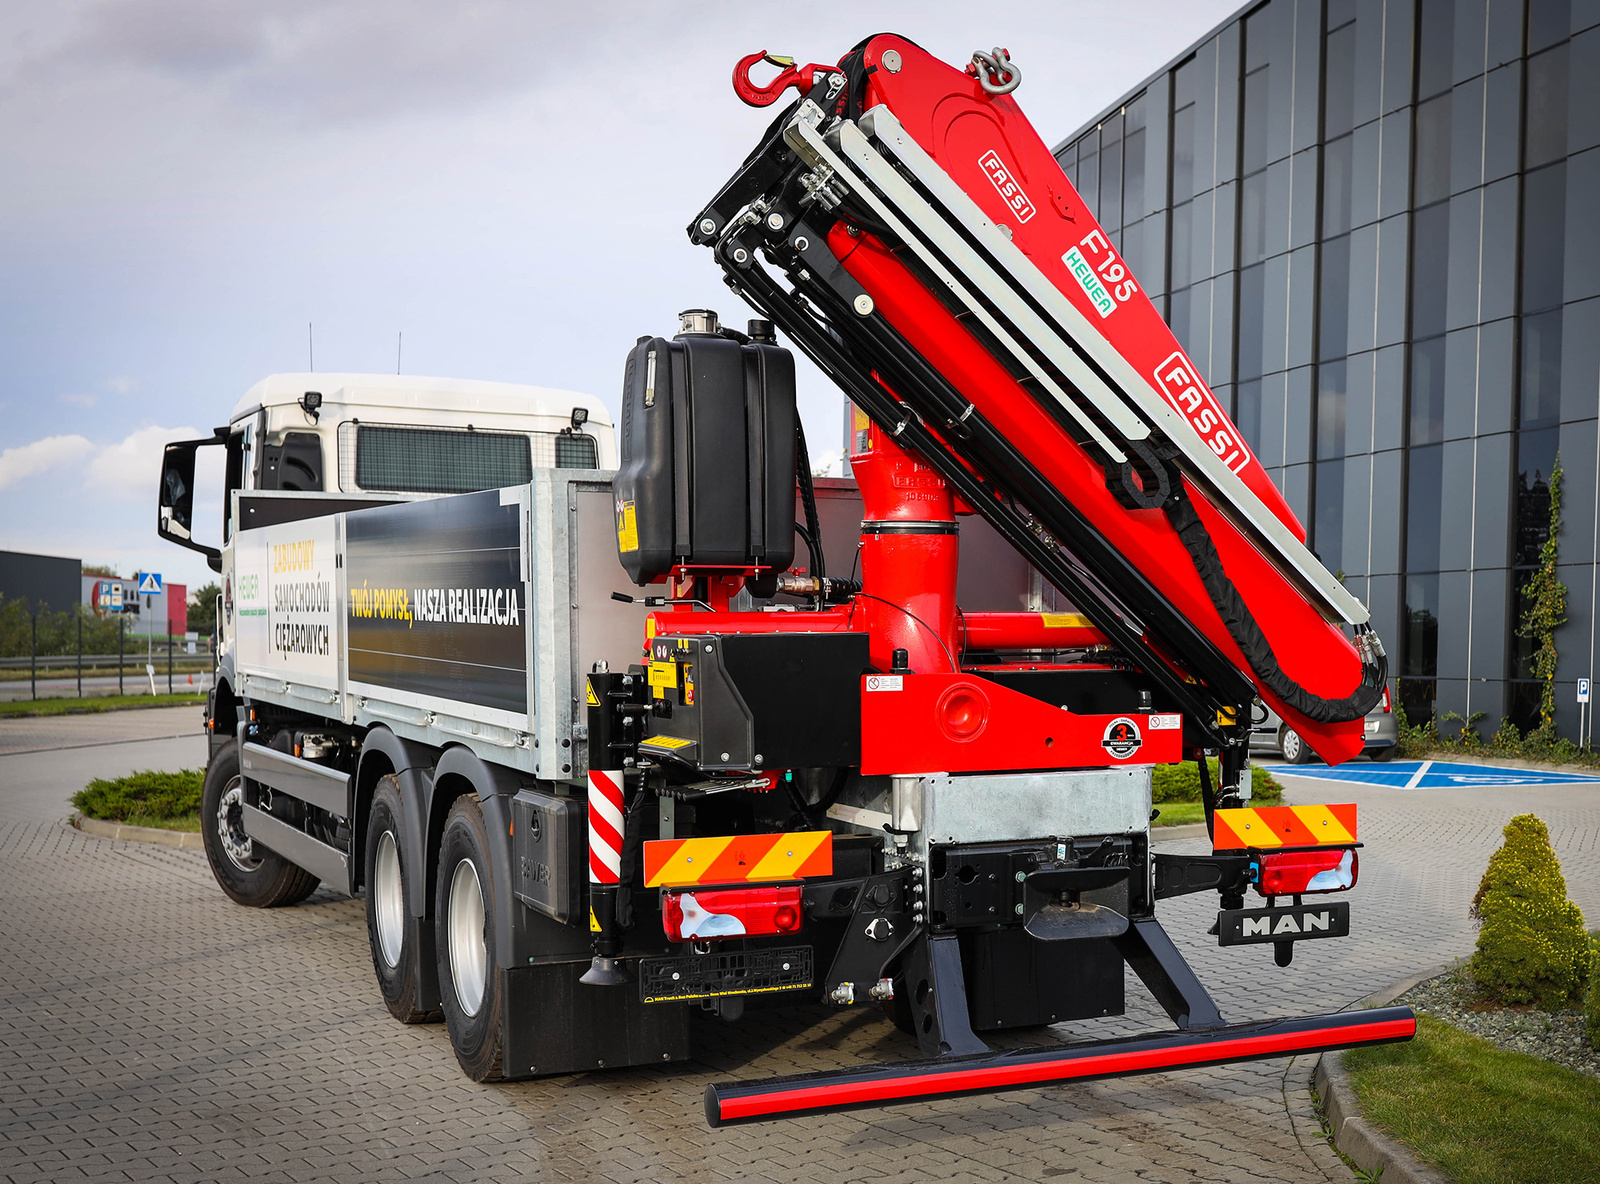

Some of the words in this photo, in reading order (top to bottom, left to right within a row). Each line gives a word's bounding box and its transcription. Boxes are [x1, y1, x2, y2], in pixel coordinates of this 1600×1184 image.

[984, 158, 1031, 217] FASSI
[1066, 251, 1112, 313] HEWEA
[1080, 229, 1138, 302] F195
[1165, 366, 1240, 466] FASSI
[274, 539, 315, 574] ZABUDOWY
[275, 571, 330, 613] SAMOCHODÓW
[351, 579, 373, 618] TWÓJ
[414, 588, 447, 622] NASZA
[449, 588, 520, 626] REALIZACJA
[275, 615, 329, 661] CIĘŻAROWYCH
[1580, 681, 1587, 694] P
[1116, 724, 1128, 742] 3
[1242, 911, 1330, 937] MAN
